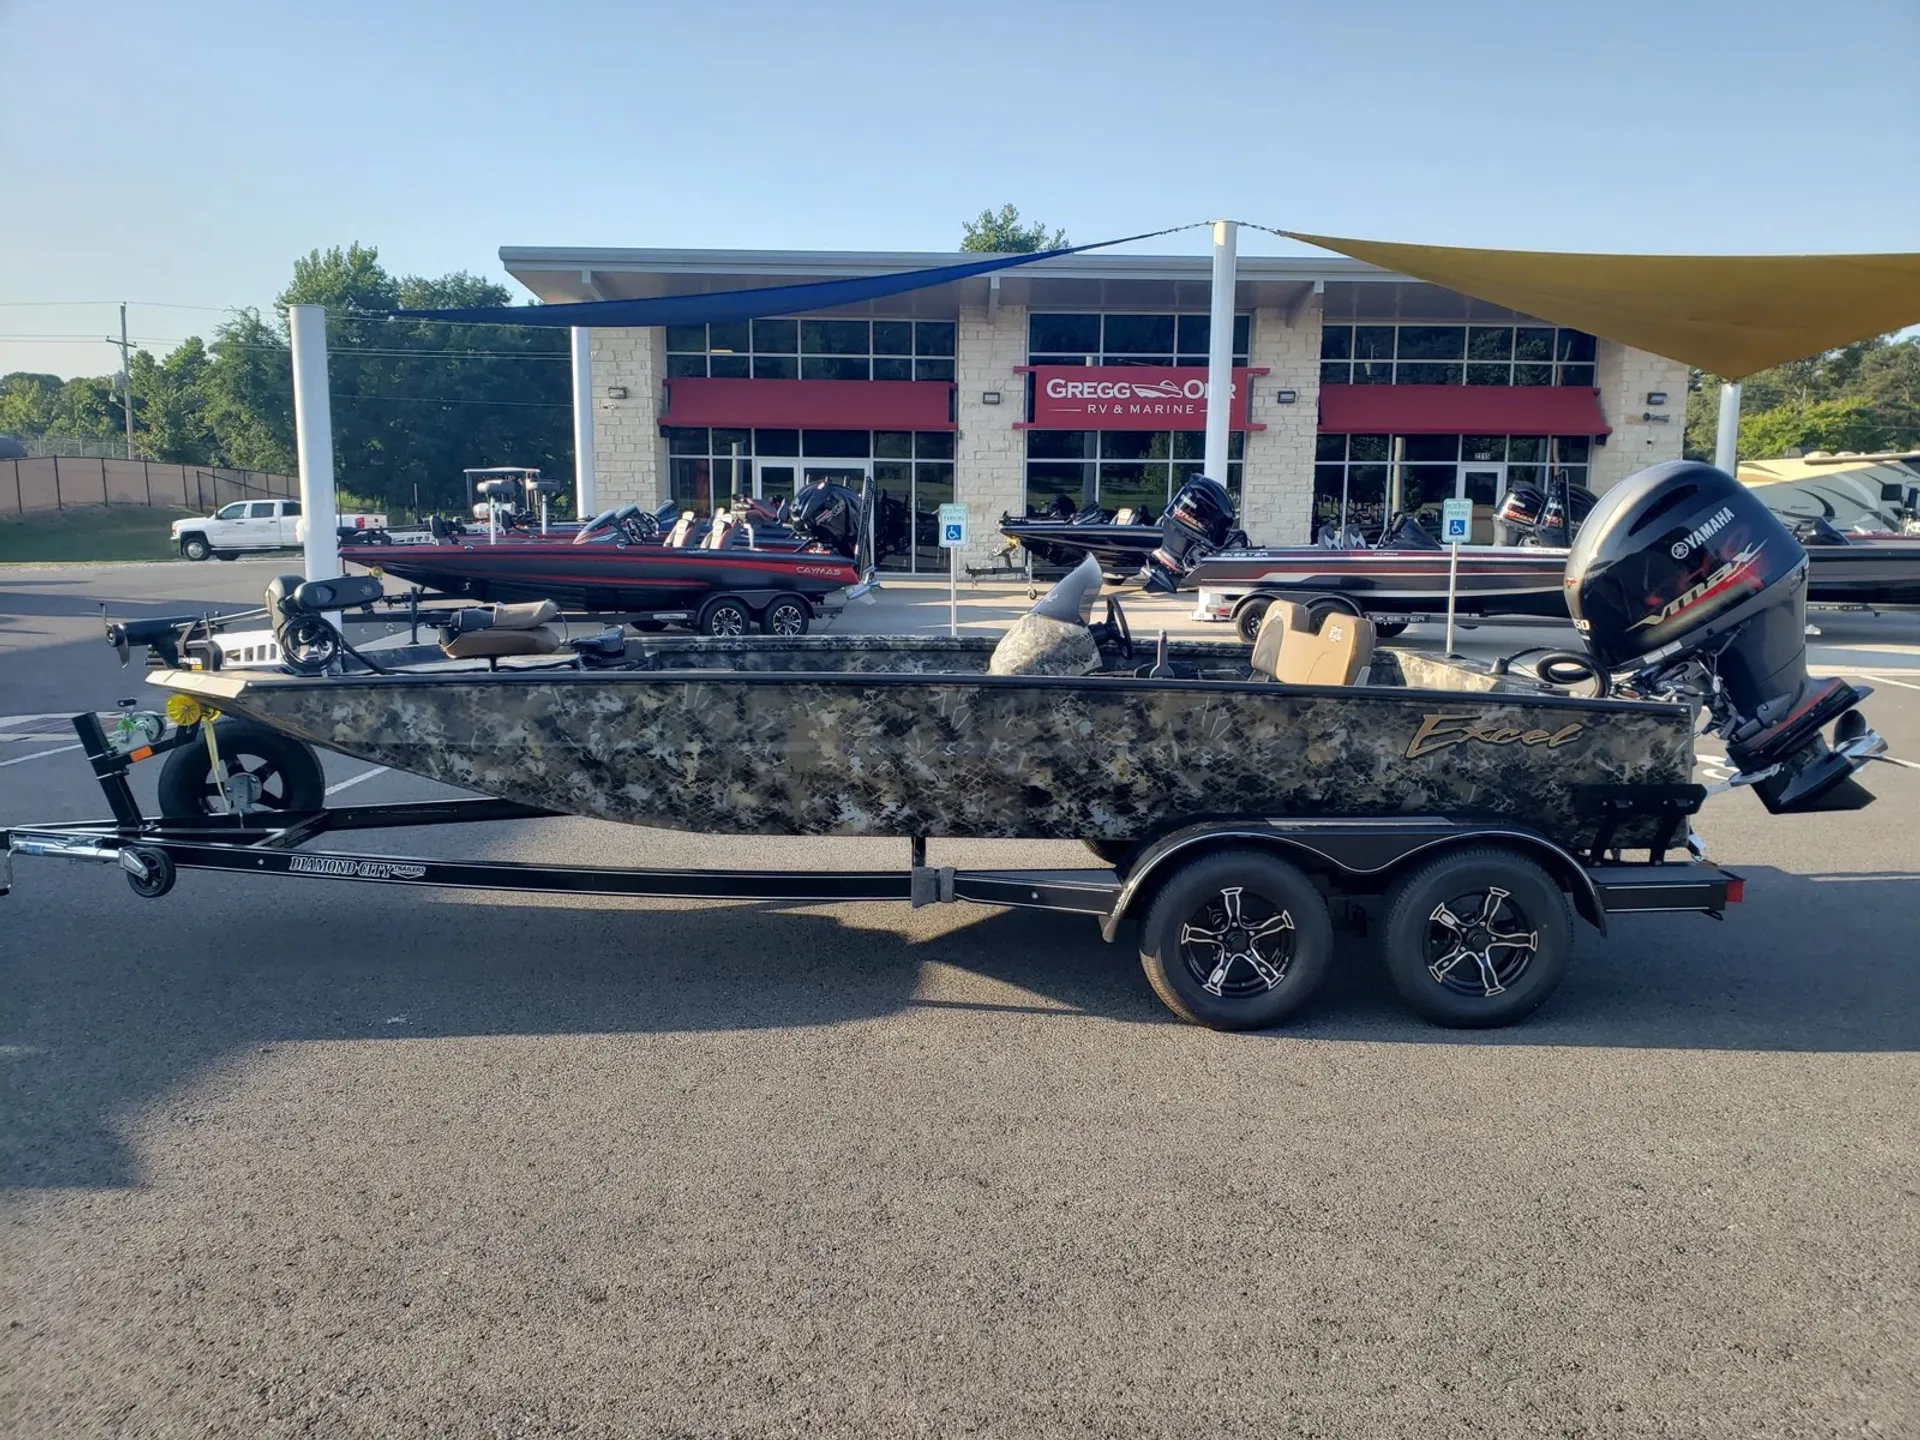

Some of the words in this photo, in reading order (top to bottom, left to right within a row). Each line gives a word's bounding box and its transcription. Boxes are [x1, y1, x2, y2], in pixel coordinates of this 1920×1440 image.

[1046, 378, 1131, 399] GREGG
[1087, 404, 1108, 414] RV
[1113, 404, 1123, 414] &
[1129, 404, 1194, 414] MARINE
[1686, 506, 1736, 549] YAMAHA
[796, 566, 842, 576] CAYMAS
[1405, 713, 1584, 759] Excel
[288, 855, 358, 876] DIAMOND
